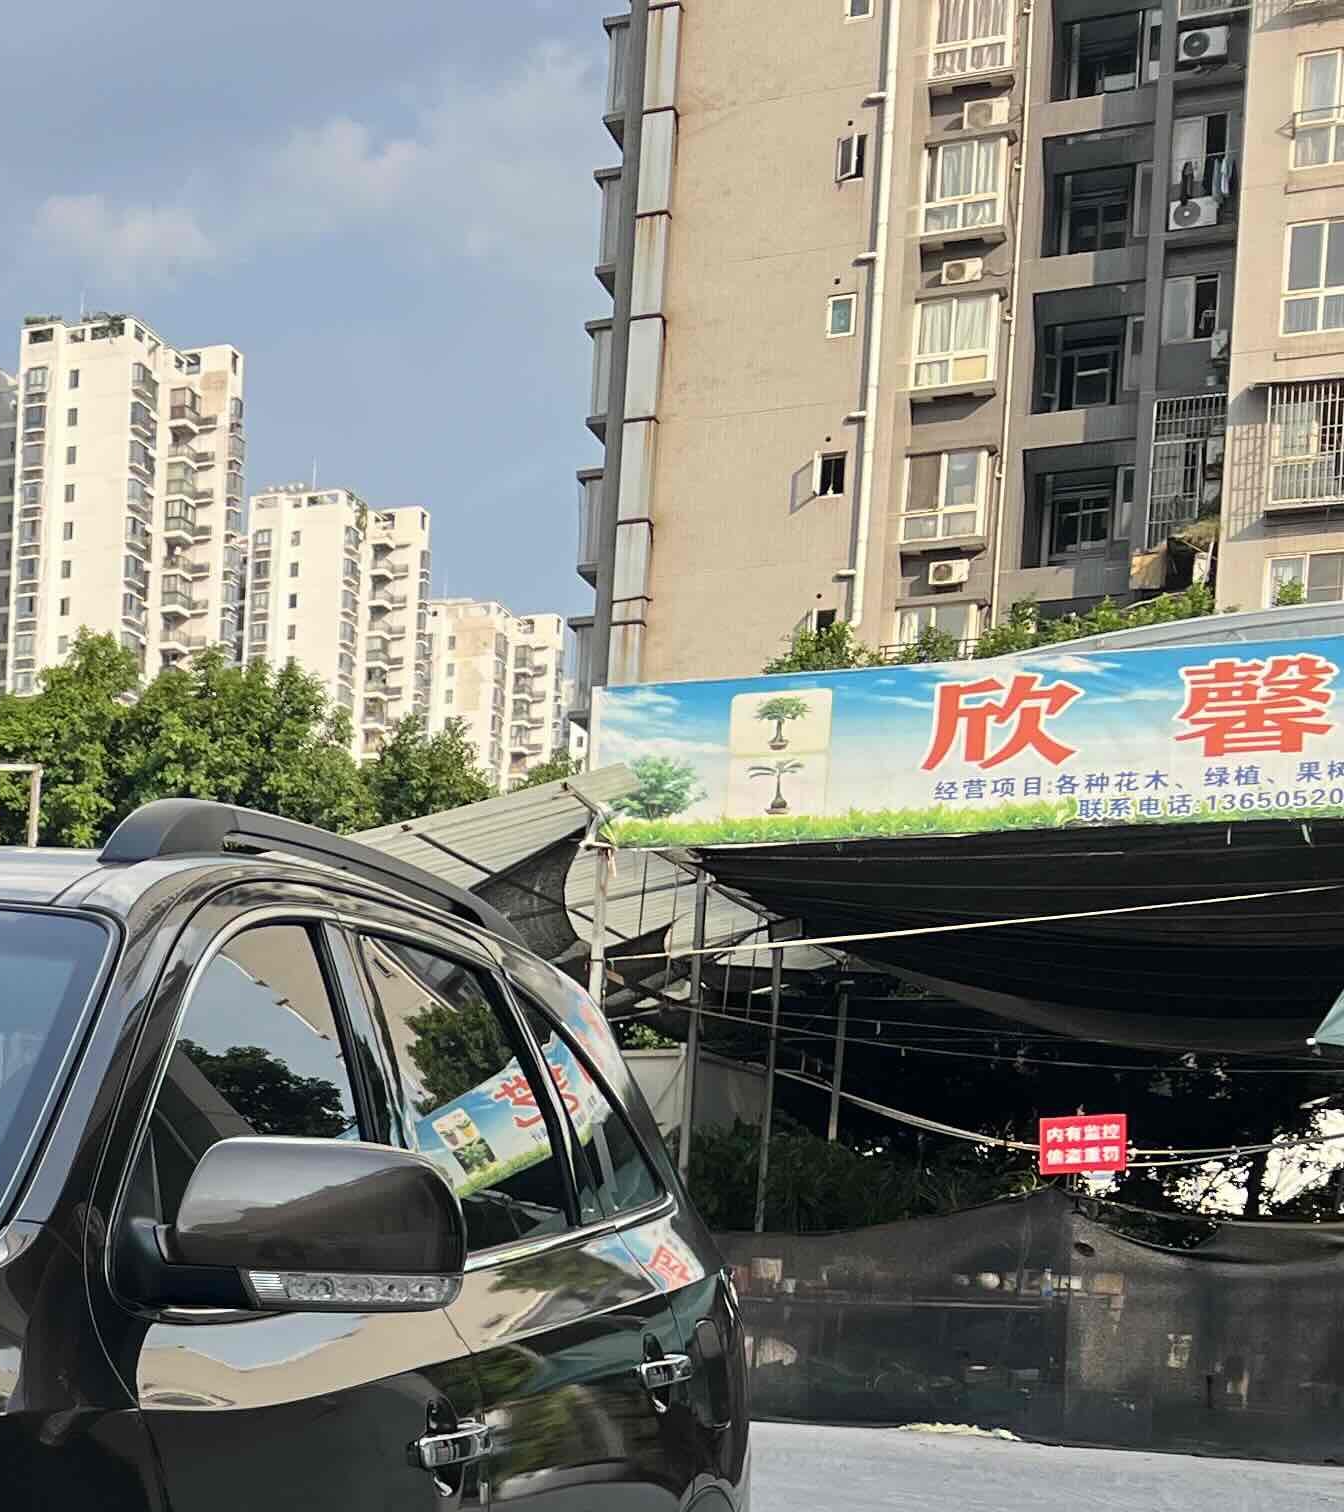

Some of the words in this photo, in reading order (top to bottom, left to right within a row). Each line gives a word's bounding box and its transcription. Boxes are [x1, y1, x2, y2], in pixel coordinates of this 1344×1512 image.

[921, 652, 1339, 770] 欣馨
[1047, 1124, 1121, 1143] 内有监控
